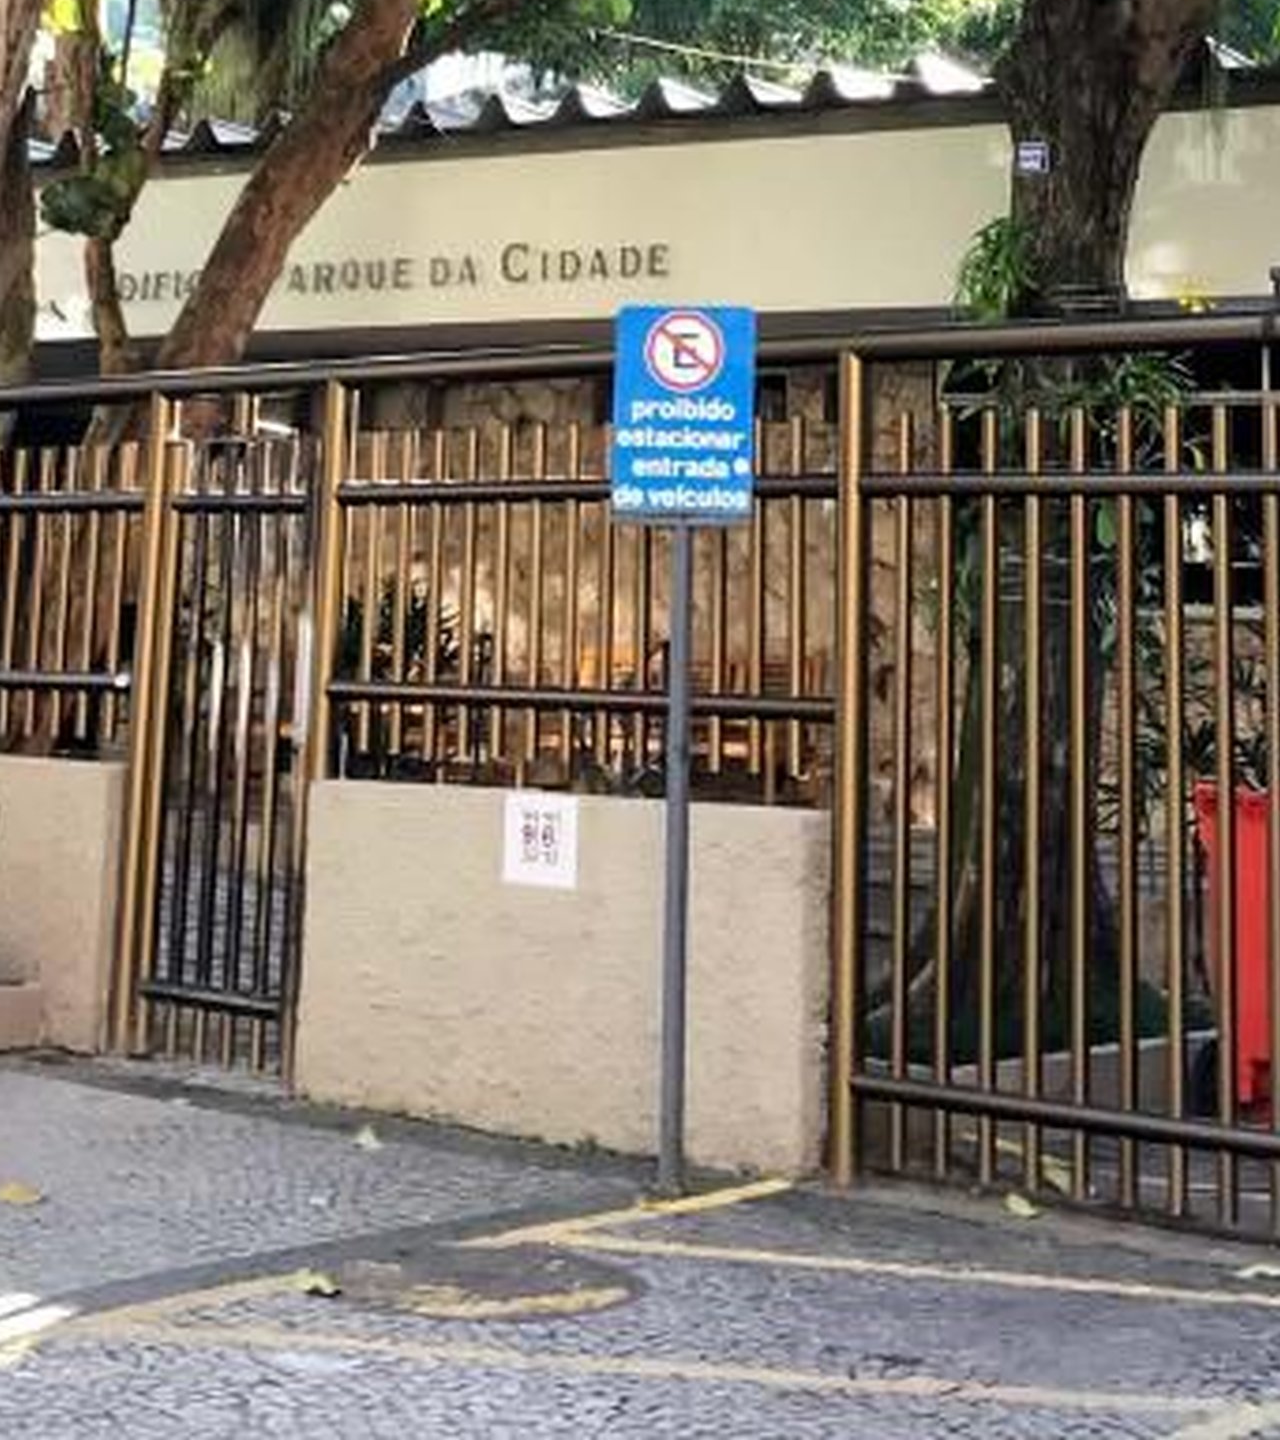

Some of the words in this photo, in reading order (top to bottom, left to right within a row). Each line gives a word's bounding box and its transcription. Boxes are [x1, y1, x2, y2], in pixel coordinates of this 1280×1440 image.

[285, 257, 414, 295] ARQUE
[429, 255, 477, 288] DA
[500, 242, 670, 284] CIDADE
[631, 396, 736, 424] proibido
[617, 426, 746, 450] estacionar
[631, 456, 730, 479] entrada
[612, 484, 644, 509] de
